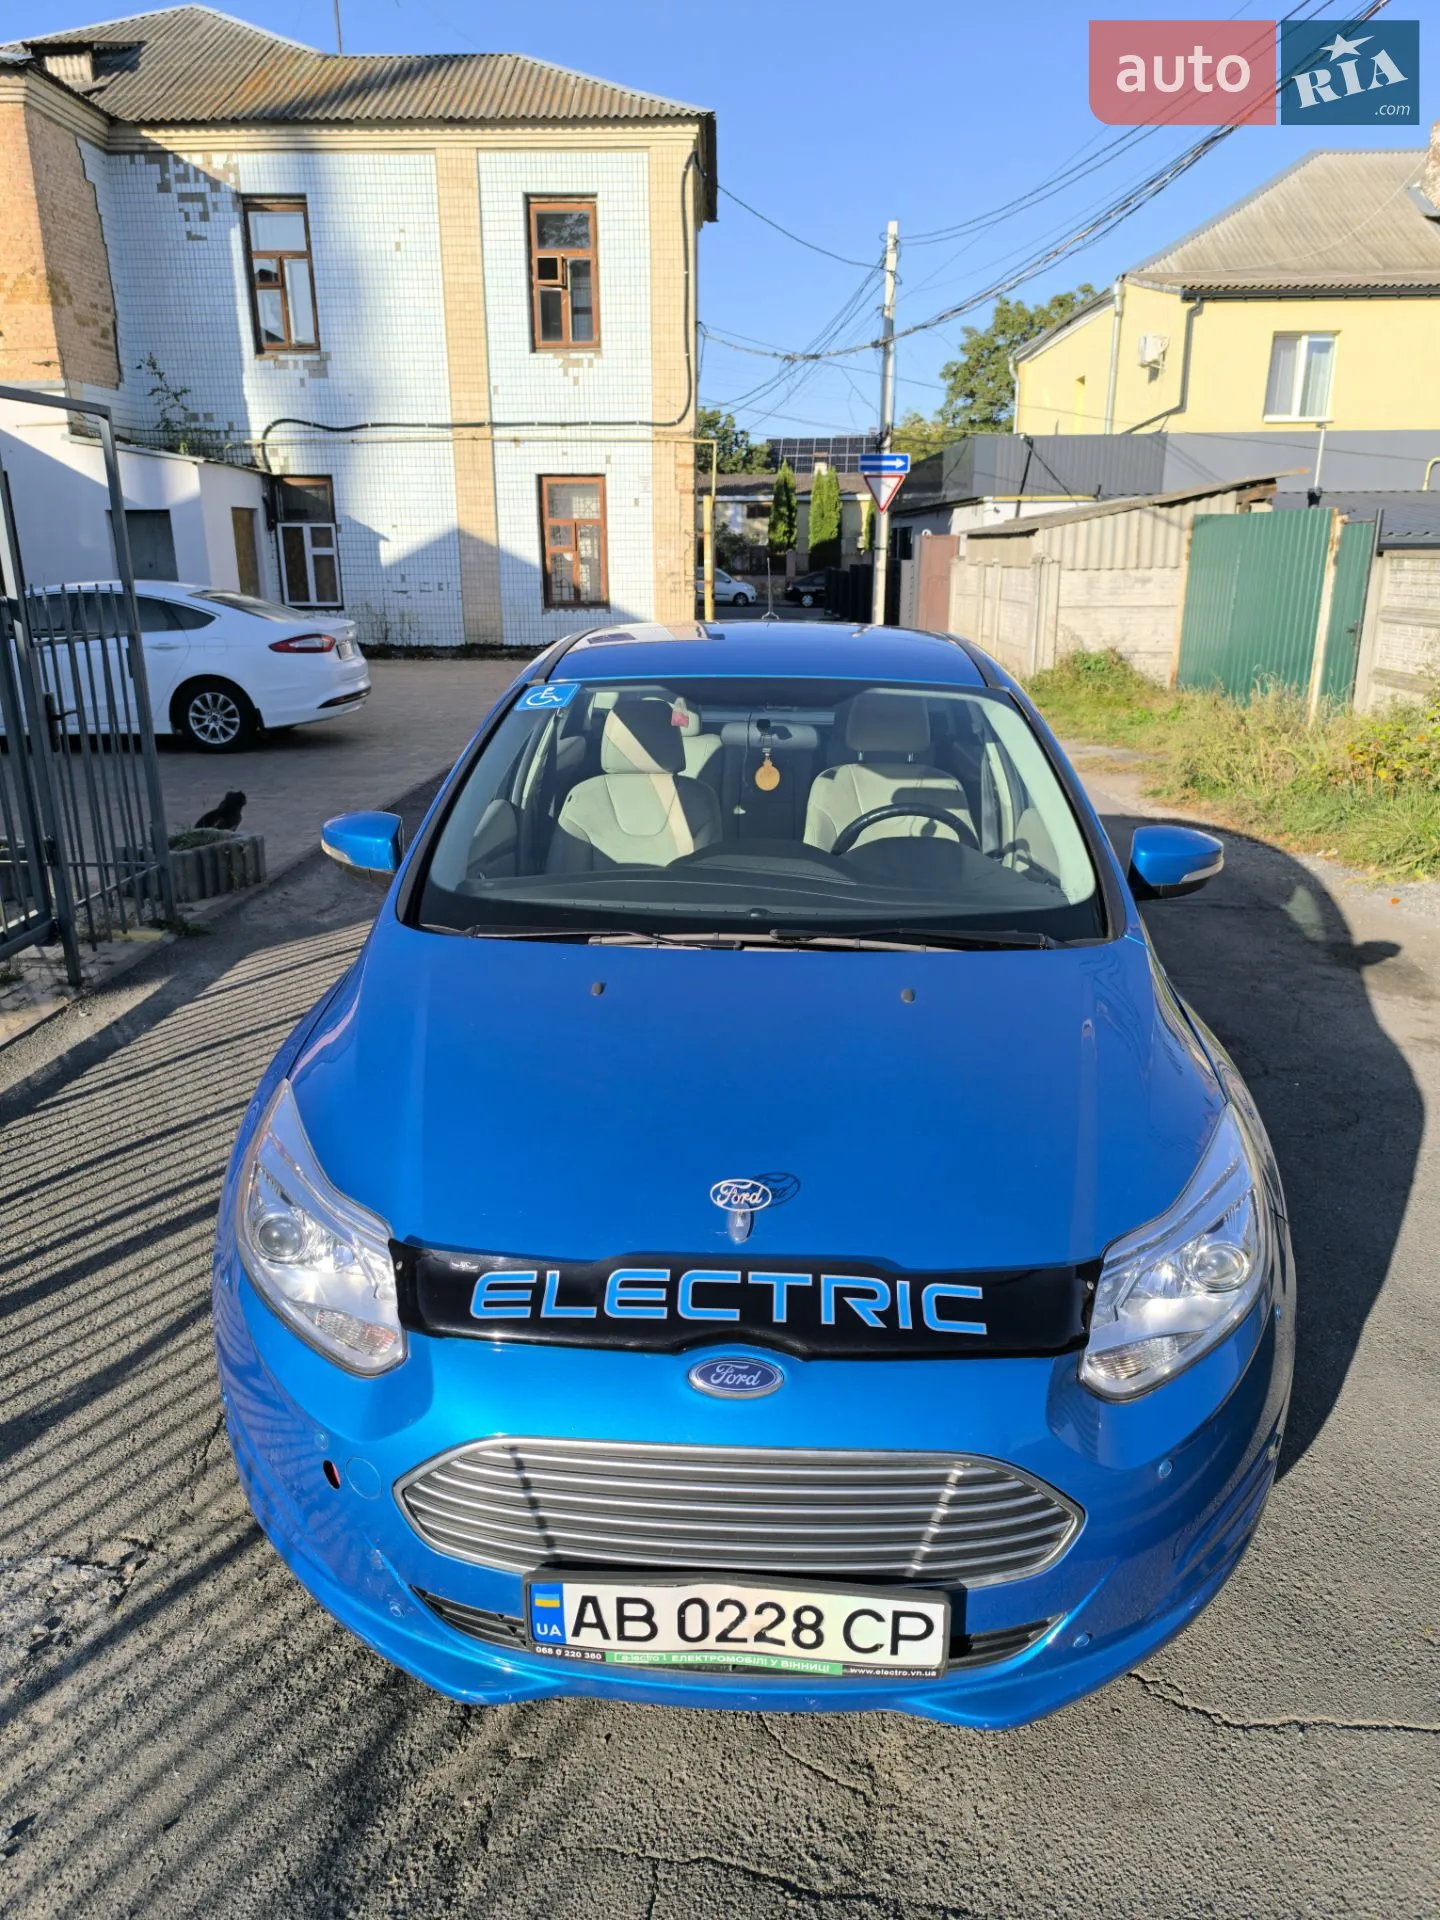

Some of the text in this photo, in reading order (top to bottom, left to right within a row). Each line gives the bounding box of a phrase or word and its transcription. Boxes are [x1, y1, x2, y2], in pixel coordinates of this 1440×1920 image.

[716, 1182, 765, 1206] Ford
[469, 1269, 988, 1336] ELECTRIC
[710, 1363, 762, 1386] Ford
[536, 1622, 562, 1637] UA
[571, 1595, 935, 1656] AB 0228 CP
[850, 1666, 937, 1678] www.electro.vn.ua
